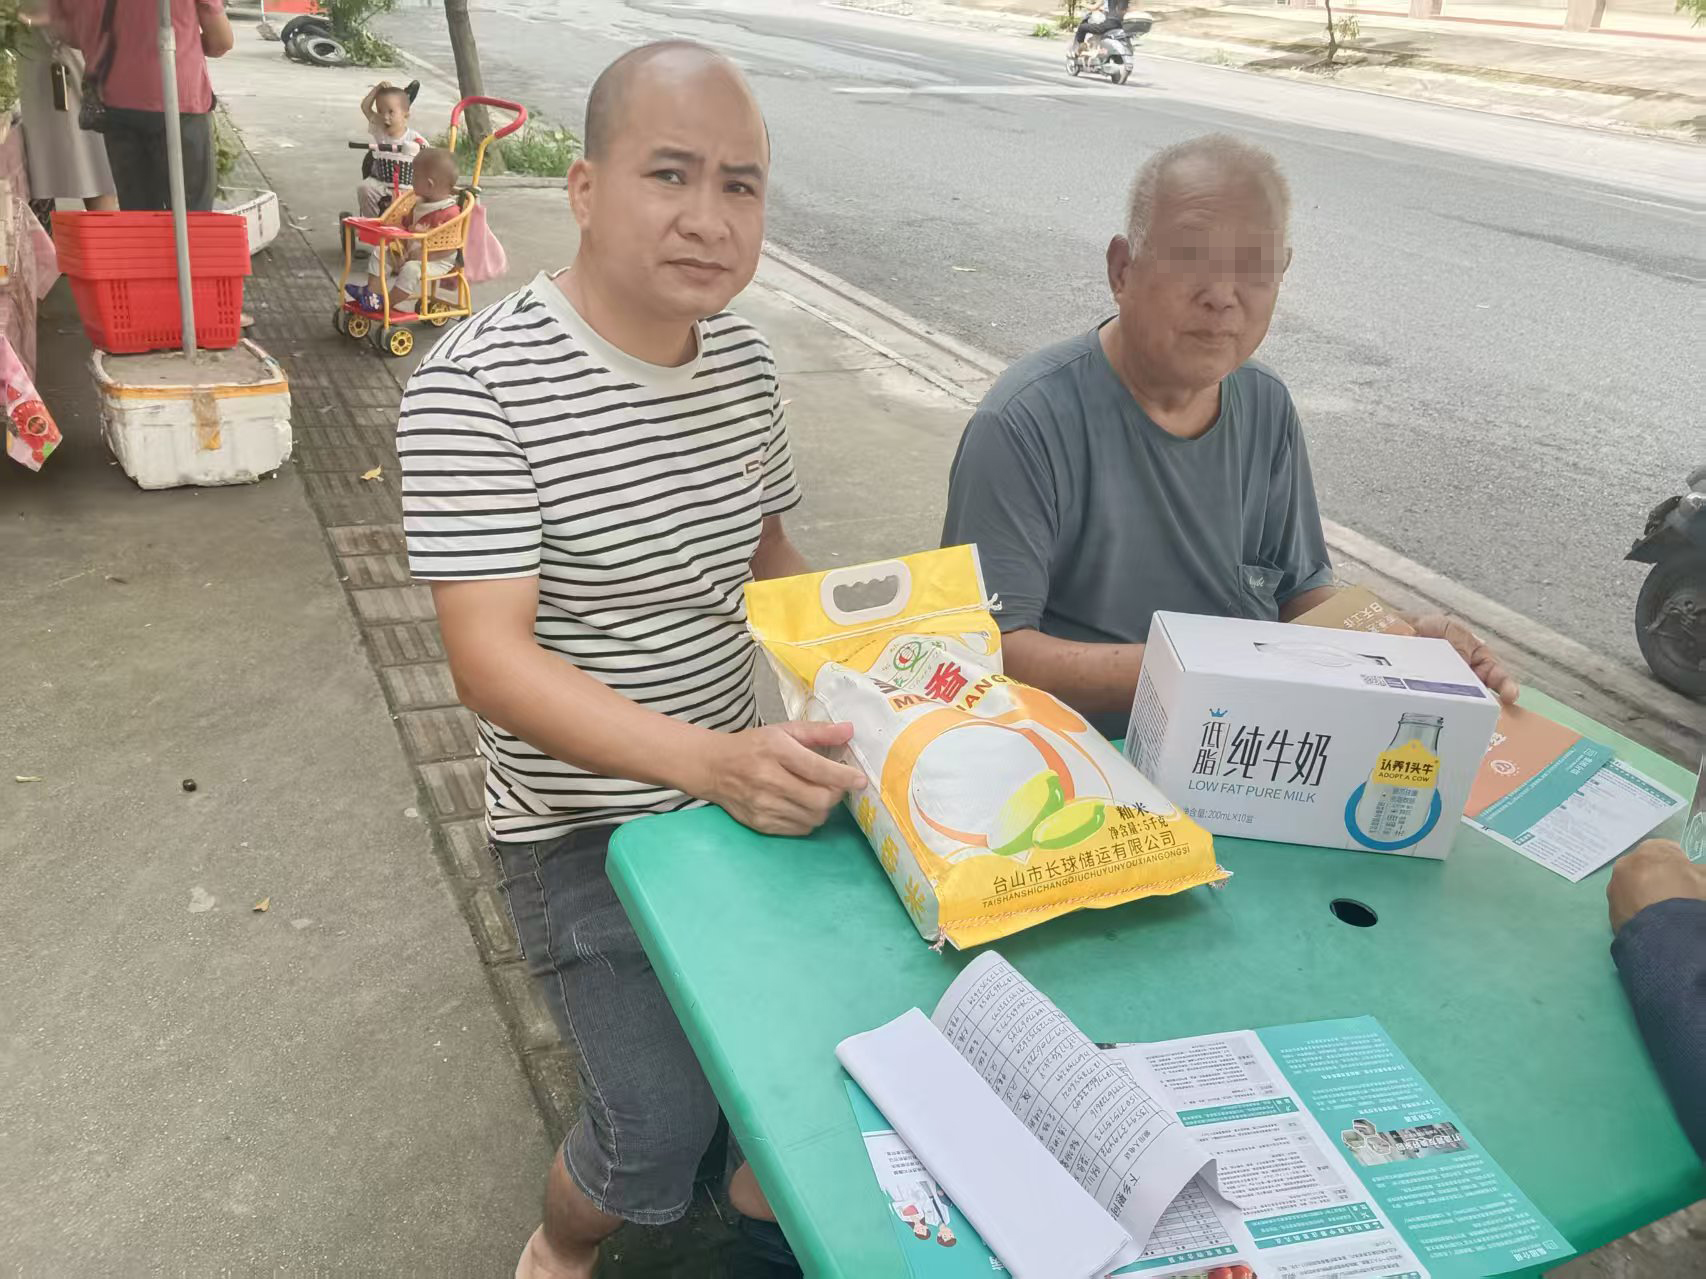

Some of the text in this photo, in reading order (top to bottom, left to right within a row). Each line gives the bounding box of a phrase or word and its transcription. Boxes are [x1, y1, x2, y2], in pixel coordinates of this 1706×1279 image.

[923, 660, 969, 704] 香
[1191, 721, 1225, 776] 低脂
[1223, 725, 1332, 787] 纯牛奶
[1378, 772, 1402, 780] ADOPT
[1412, 775, 1430, 783] COW
[1380, 758, 1435, 776] 认养1头牛
[1188, 779, 1317, 804] LOW FAT PURE MILK
[1116, 802, 1150, 821] 籼米
[992, 830, 1177, 895] 台山市长球储运有限公司
